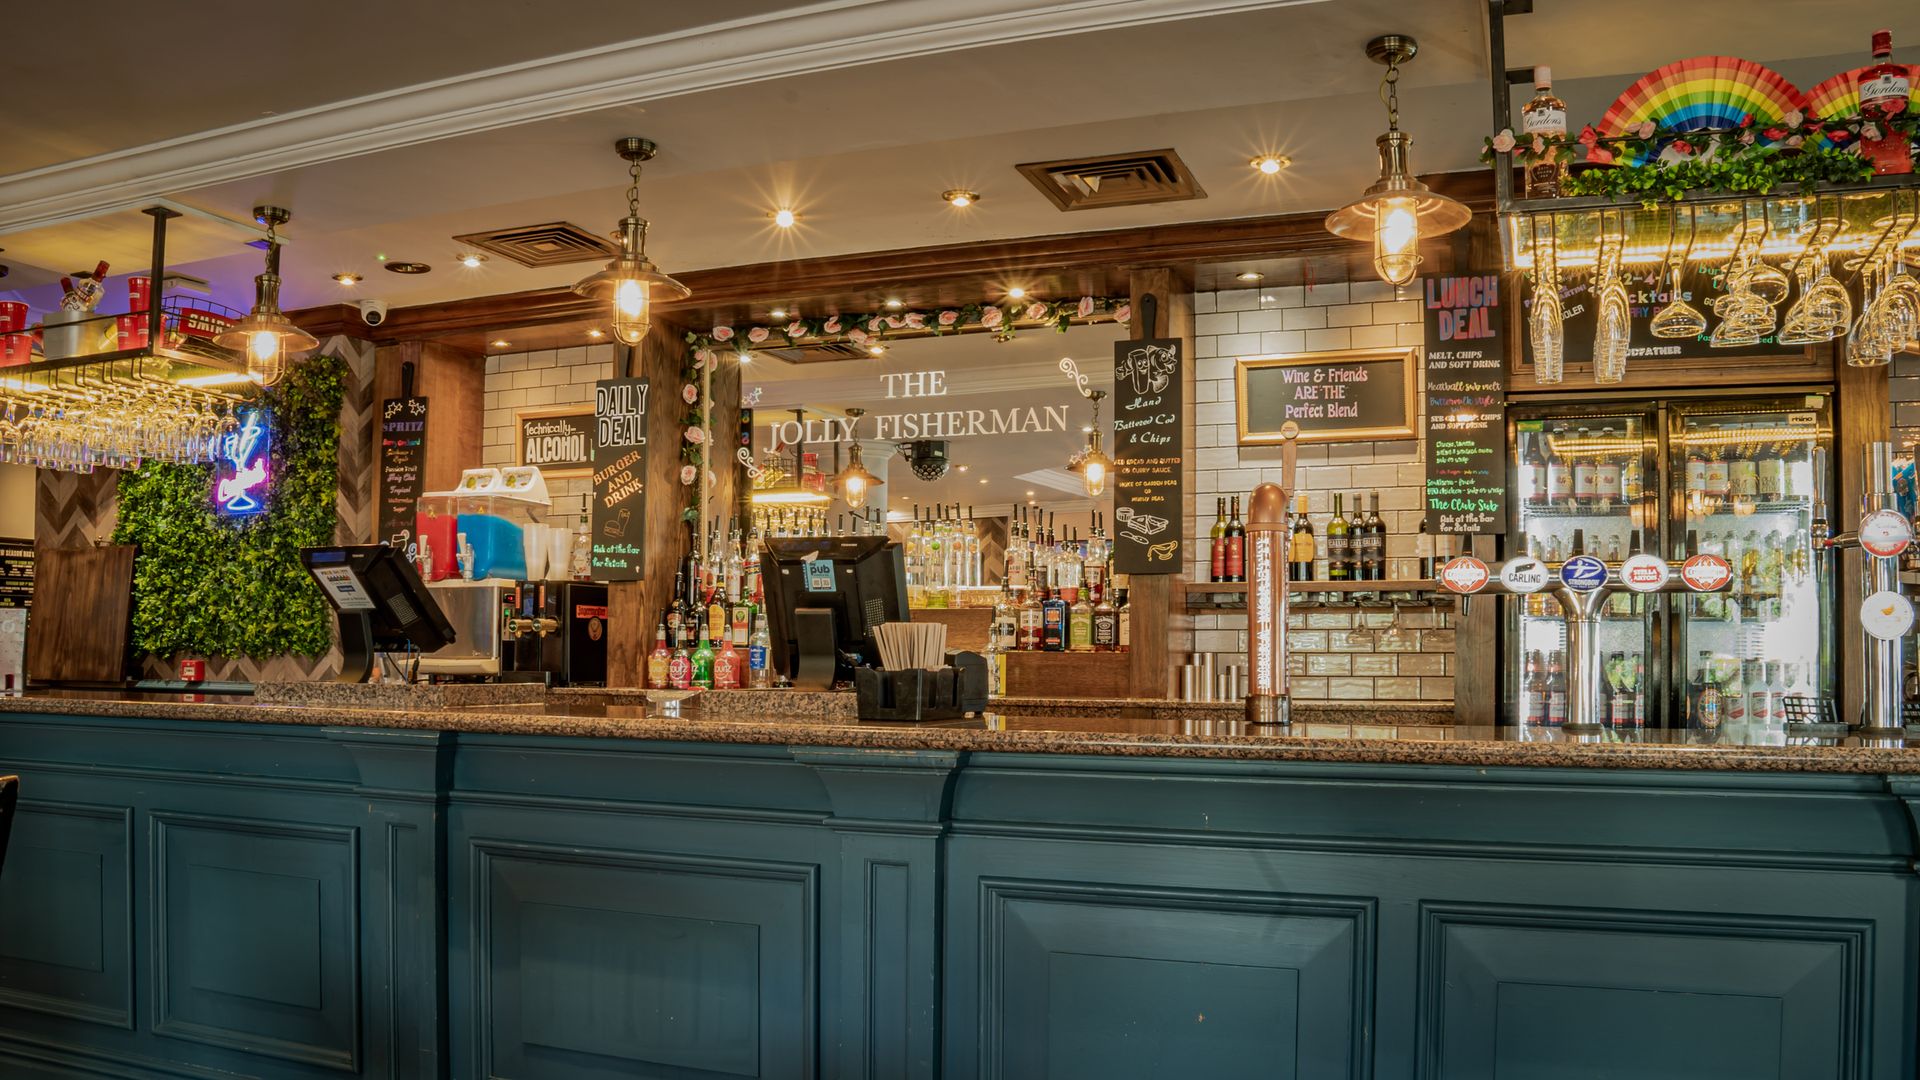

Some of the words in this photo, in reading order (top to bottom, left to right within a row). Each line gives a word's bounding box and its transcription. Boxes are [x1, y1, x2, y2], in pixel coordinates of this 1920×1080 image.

[1427, 275, 1498, 309] LUNCH
[1439, 307, 1496, 341] DEAL
[1456, 351, 1482, 359] CHIPS
[1428, 361, 1447, 369] AND
[1472, 360, 1500, 368] DRINK
[1282, 368, 1310, 384] Wine
[1313, 368, 1326, 382] &
[1328, 366, 1368, 382] Friends
[880, 370, 948, 399] THE
[1294, 385, 1319, 400] ARE
[1321, 385, 1346, 400] THE
[595, 384, 649, 417] DAILY
[1125, 396, 1162, 410] Hand
[1285, 403, 1324, 419] Perfect
[1327, 402, 1358, 418] Blend
[382, 421, 424, 432] SPRITZ
[599, 415, 647, 447] DEAL
[763, 417, 860, 453] JOLLY
[875, 405, 1070, 440] FISHERMAN
[1114, 416, 1153, 431] Battered
[1155, 414, 1176, 425] Cod
[1130, 433, 1137, 443] &
[1140, 431, 1171, 445] Chips
[526, 434, 587, 463] ALCOHOL
[593, 450, 642, 486] BURGER
[608, 470, 632, 493] AND
[604, 478, 643, 508] DRINK
[1429, 498, 1450, 510] The
[1451, 498, 1476, 511] Club
[1477, 498, 1499, 511] Sub
[1440, 514, 1454, 523] Ask
[1455, 514, 1464, 523] at
[1465, 512, 1479, 522] the
[1479, 512, 1494, 522] bar
[1440, 522, 1453, 532] for
[1454, 522, 1480, 532] details
[810, 564, 830, 576] pub
[1508, 572, 1541, 584] CARLING
